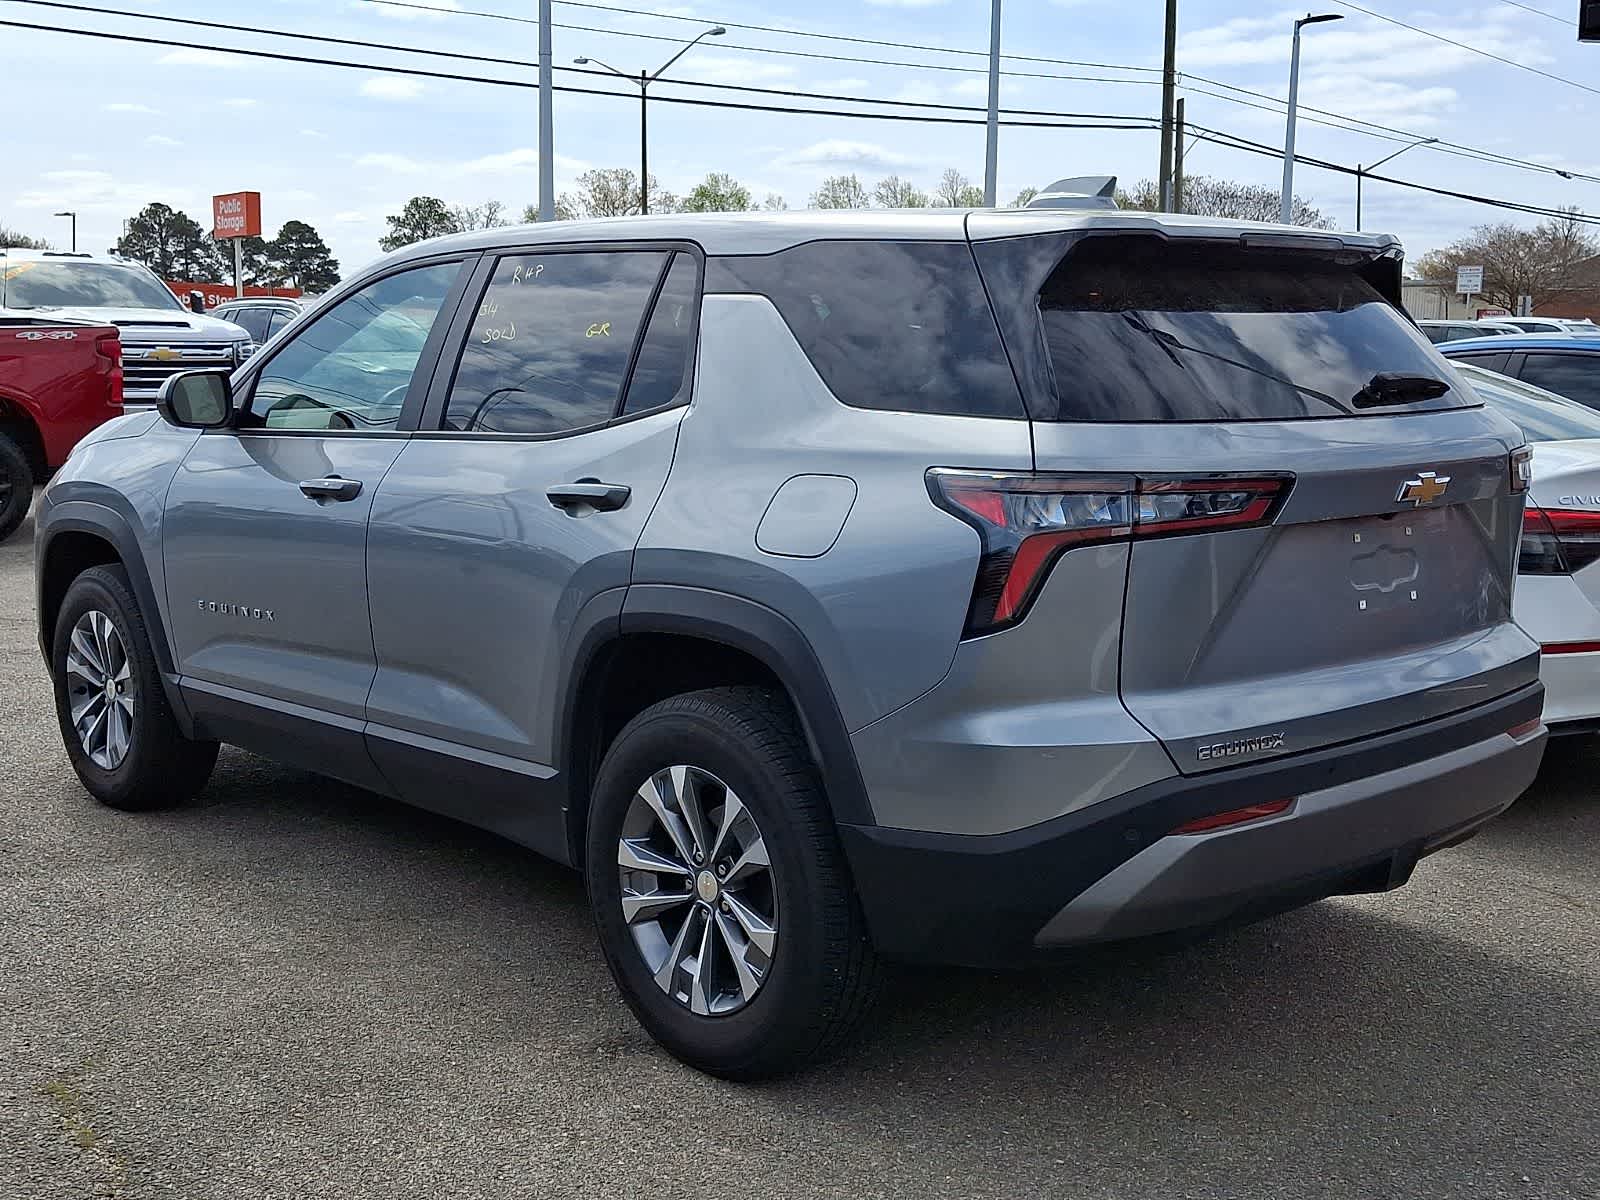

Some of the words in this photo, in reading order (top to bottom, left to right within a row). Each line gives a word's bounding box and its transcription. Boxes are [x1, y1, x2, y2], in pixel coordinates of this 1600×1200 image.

[219, 199, 241, 214] Public
[481, 322, 516, 343] SOLD
[198, 599, 275, 621] EQUINOX
[1198, 731, 1285, 760] EQUINOX
